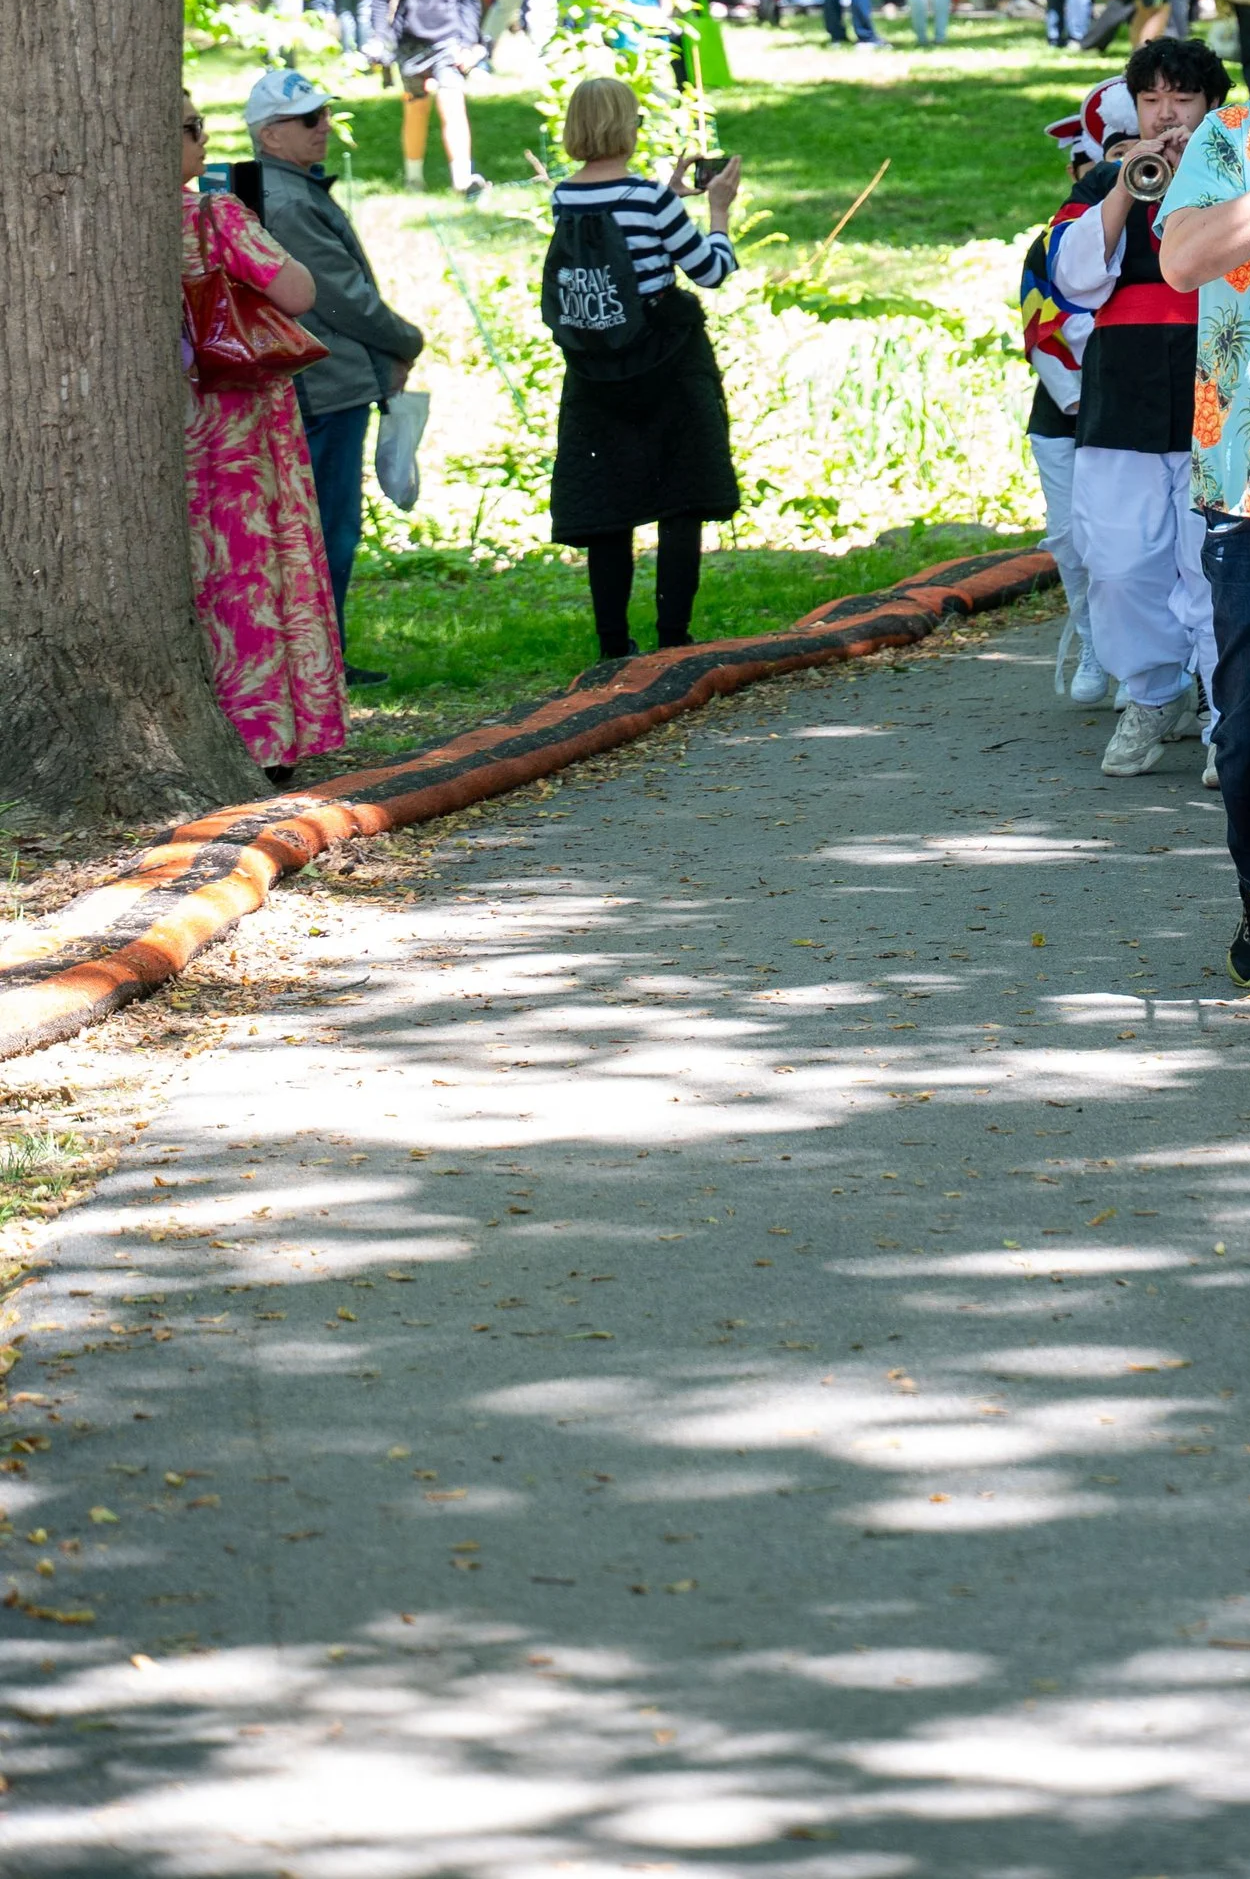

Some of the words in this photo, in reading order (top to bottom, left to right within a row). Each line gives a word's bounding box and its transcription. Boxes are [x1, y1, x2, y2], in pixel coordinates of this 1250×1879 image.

[559, 288, 623, 321] VOICES
[560, 315, 585, 329] BRAVE
[586, 314, 627, 330] CHOICES
